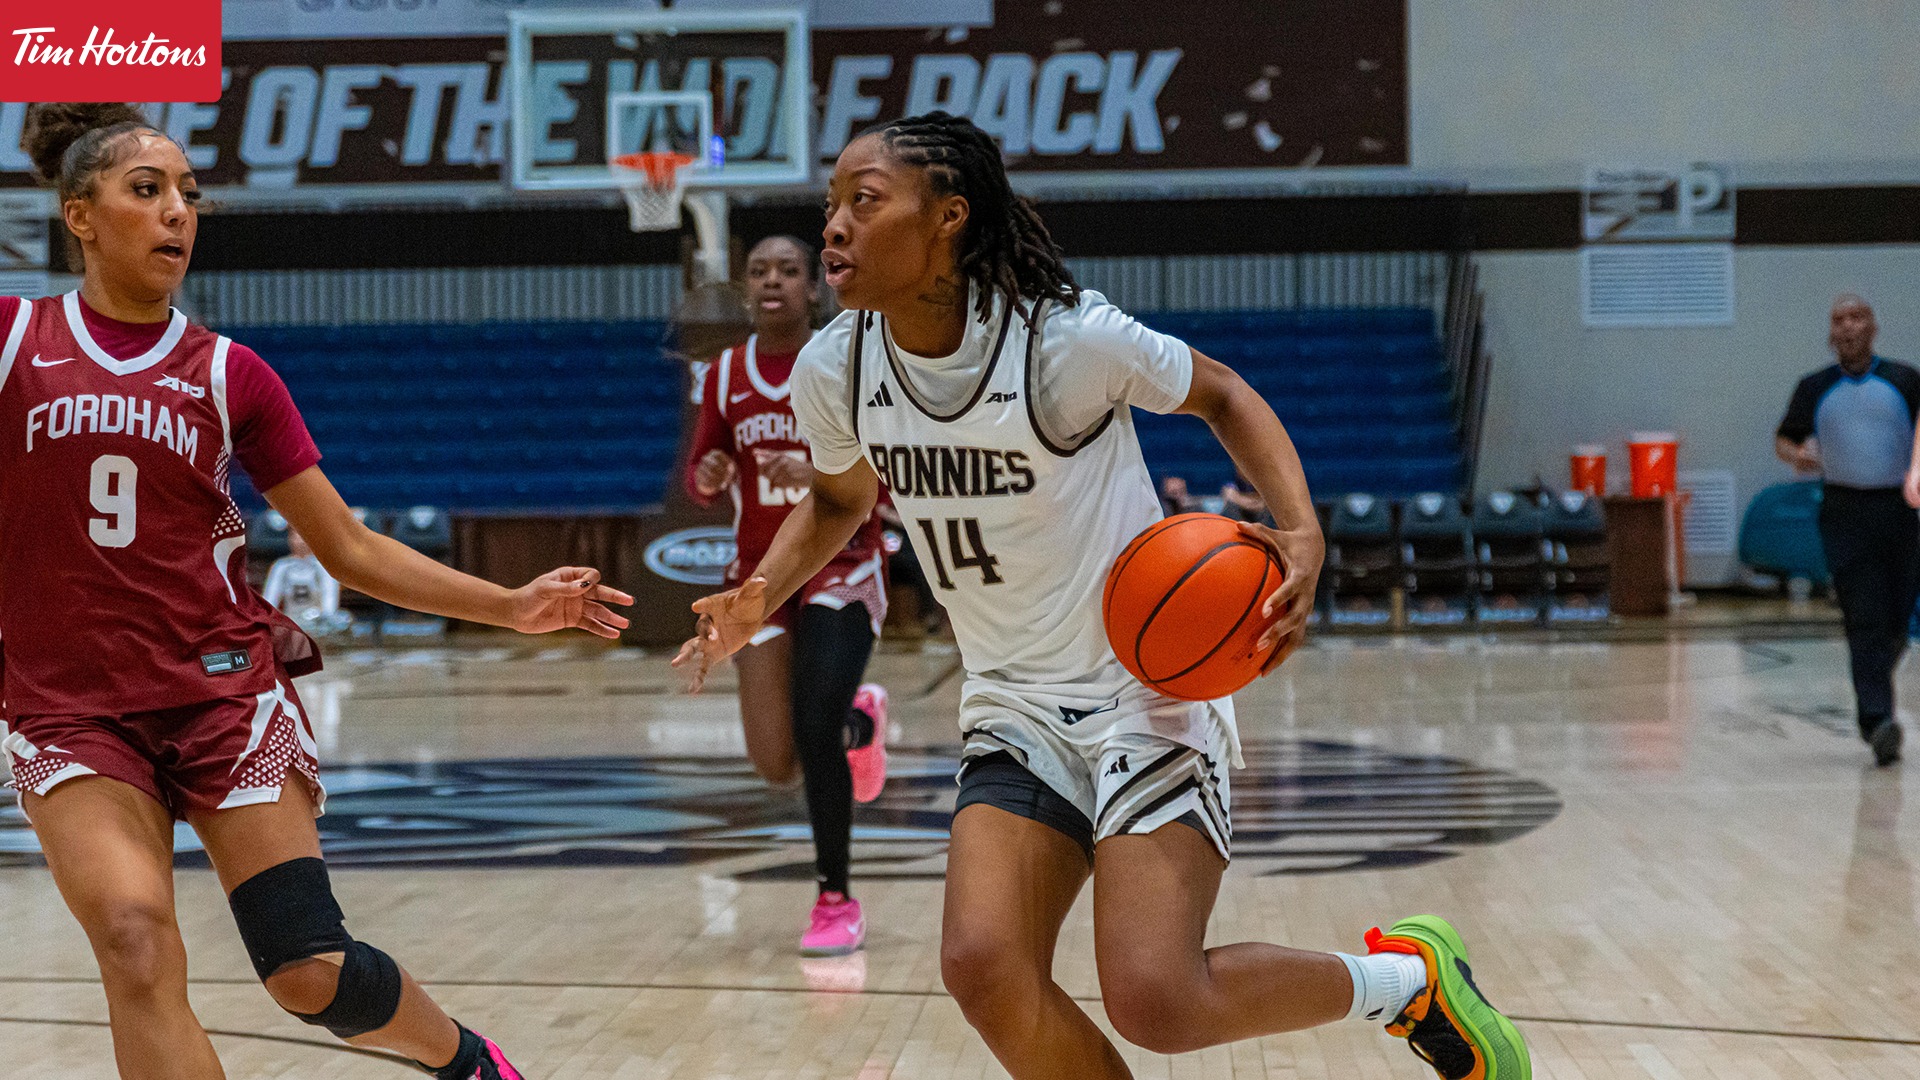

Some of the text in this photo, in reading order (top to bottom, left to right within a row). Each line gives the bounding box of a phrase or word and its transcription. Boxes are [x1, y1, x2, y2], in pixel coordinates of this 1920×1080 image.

[239, 65, 382, 168] OF
[384, 60, 591, 166] THE
[607, 54, 893, 159] WOF
[904, 48, 1184, 155] PACK
[26, 394, 198, 467] FORDHAM
[89, 454, 139, 548] 9
[868, 443, 1038, 499] BONNIES
[915, 517, 1006, 591] 14
[234, 655, 245, 665] M
